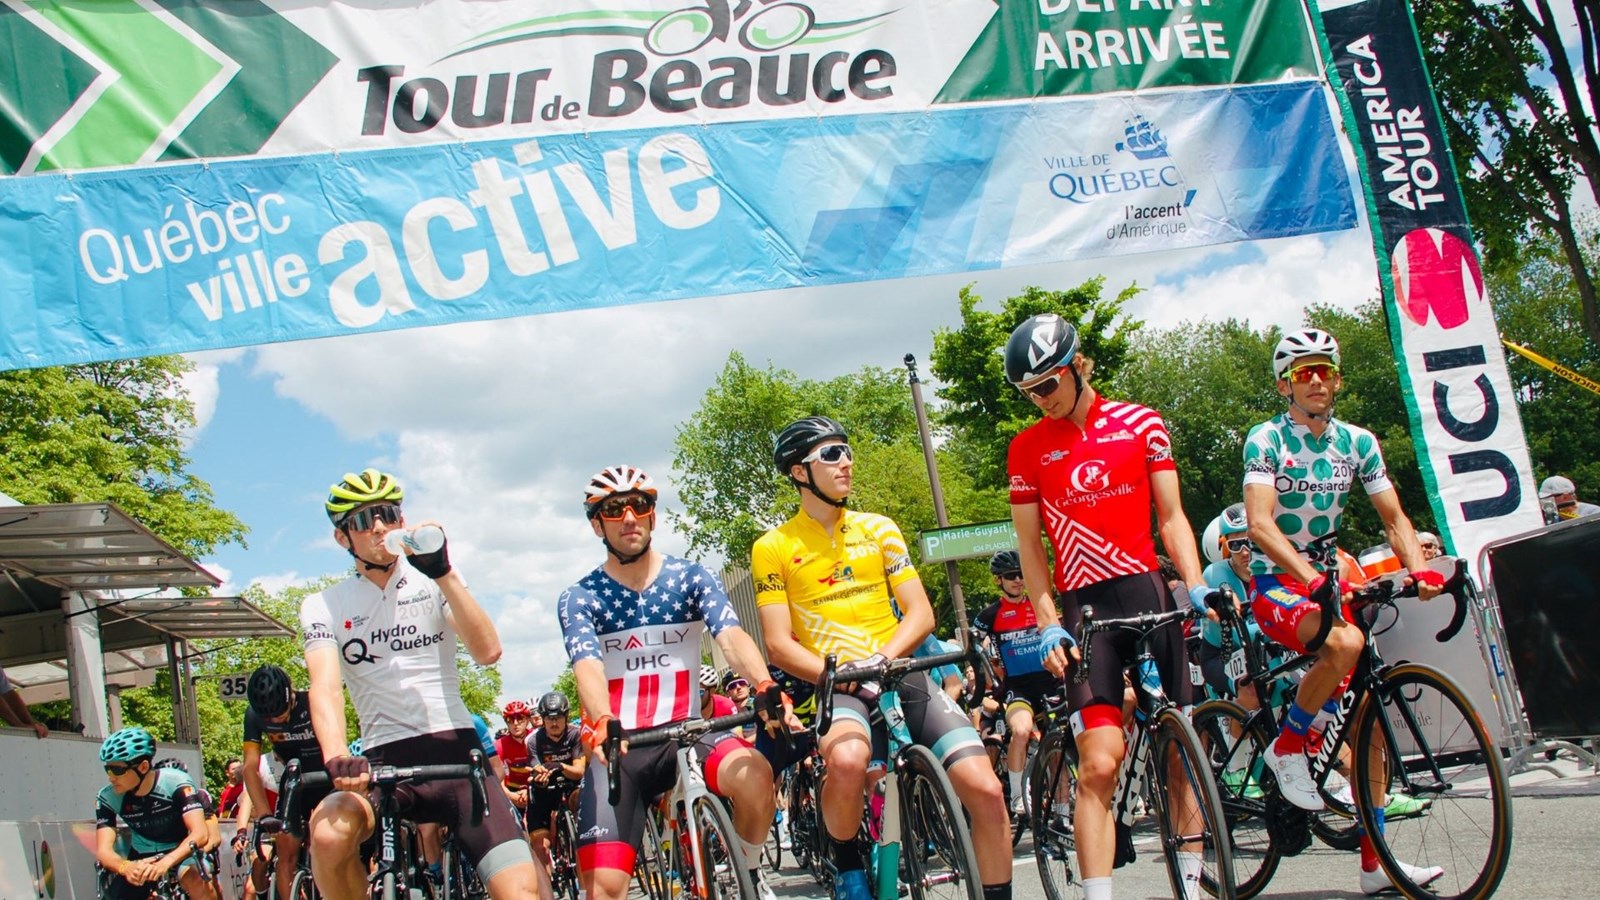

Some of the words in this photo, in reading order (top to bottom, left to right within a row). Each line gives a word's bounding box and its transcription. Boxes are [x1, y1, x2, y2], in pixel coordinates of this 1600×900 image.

[1034, 15, 1230, 70] ARRIVÉE
[357, 64, 551, 136] Tour
[540, 95, 581, 121] de
[587, 48, 897, 118] Beauce
[1346, 34, 1416, 210] AMERICA
[1044, 155, 1089, 169] VILLE
[1092, 153, 1111, 165] DE
[1396, 105, 1445, 211] TOUR
[1049, 166, 1179, 204] QUÉBEC
[79, 193, 291, 285] Québec
[317, 133, 721, 329] active
[1106, 221, 1187, 240] d'Amérique
[187, 251, 311, 322] ville
[1423, 345, 1522, 522] UCI
[1054, 483, 1137, 508] Georgesville
[1297, 480, 1352, 493] Desjardin
[943, 524, 1008, 541] Marie-Guyart
[926, 536, 940, 556] P
[398, 600, 435, 620] 2019
[371, 624, 417, 645] Hydro
[390, 631, 444, 652] Québec
[604, 628, 691, 653] RALLY
[626, 654, 671, 671] UHC
[1230, 657, 1244, 678] 102
[222, 678, 247, 696] 35
[1313, 690, 1356, 779] -WORKS
[382, 816, 395, 862] BMC
